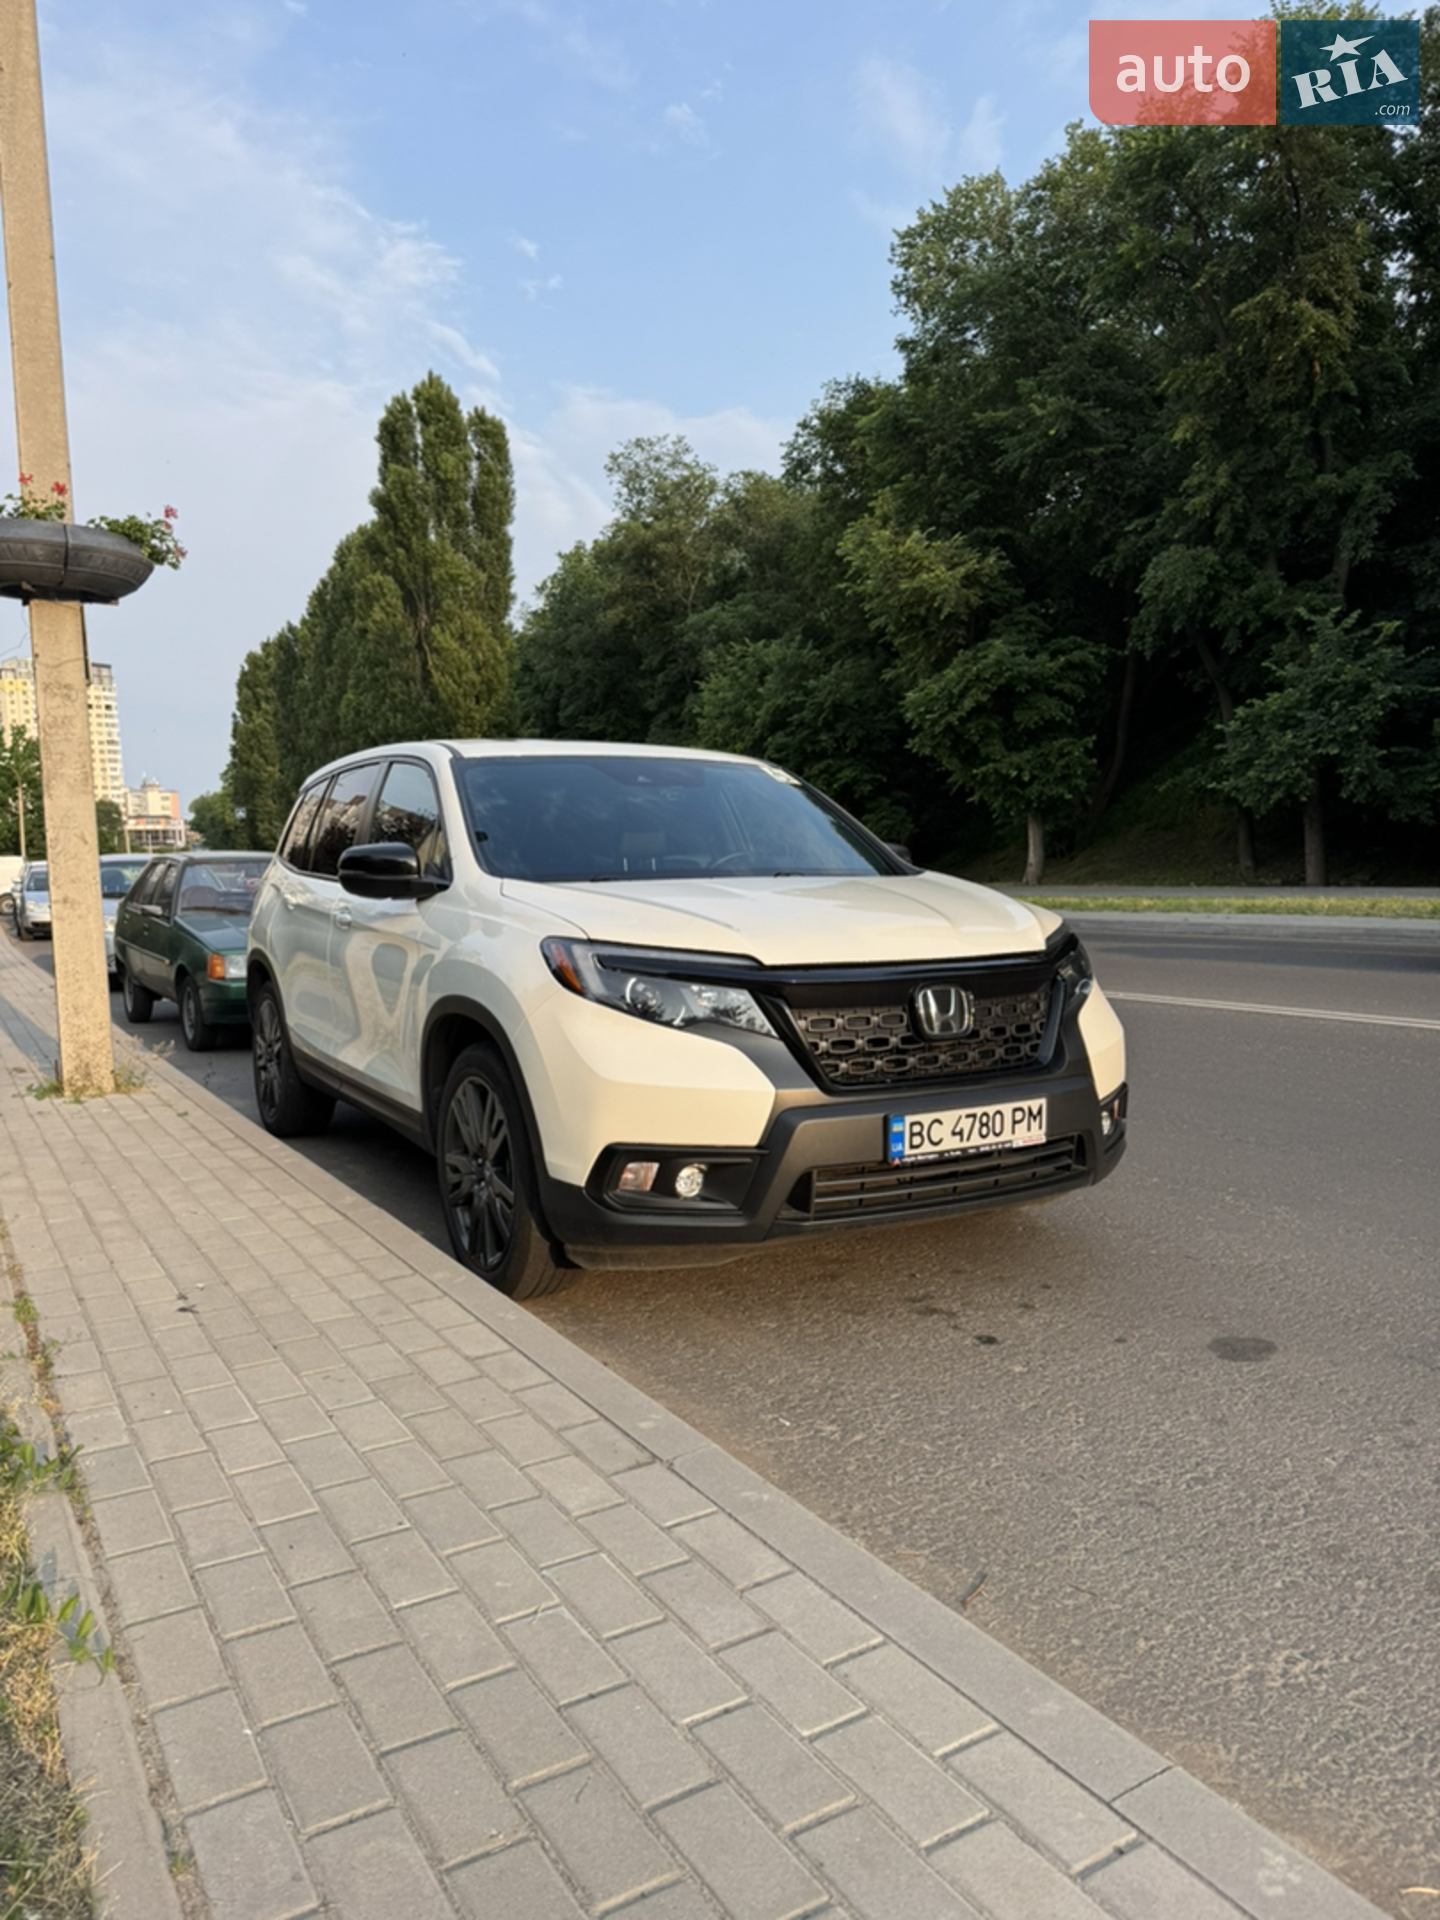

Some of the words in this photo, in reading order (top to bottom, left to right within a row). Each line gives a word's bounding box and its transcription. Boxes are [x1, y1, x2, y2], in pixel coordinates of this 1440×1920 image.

[909, 1118, 944, 1149] BC
[951, 1109, 1005, 1143] 4780
[1011, 1104, 1043, 1135] PM
